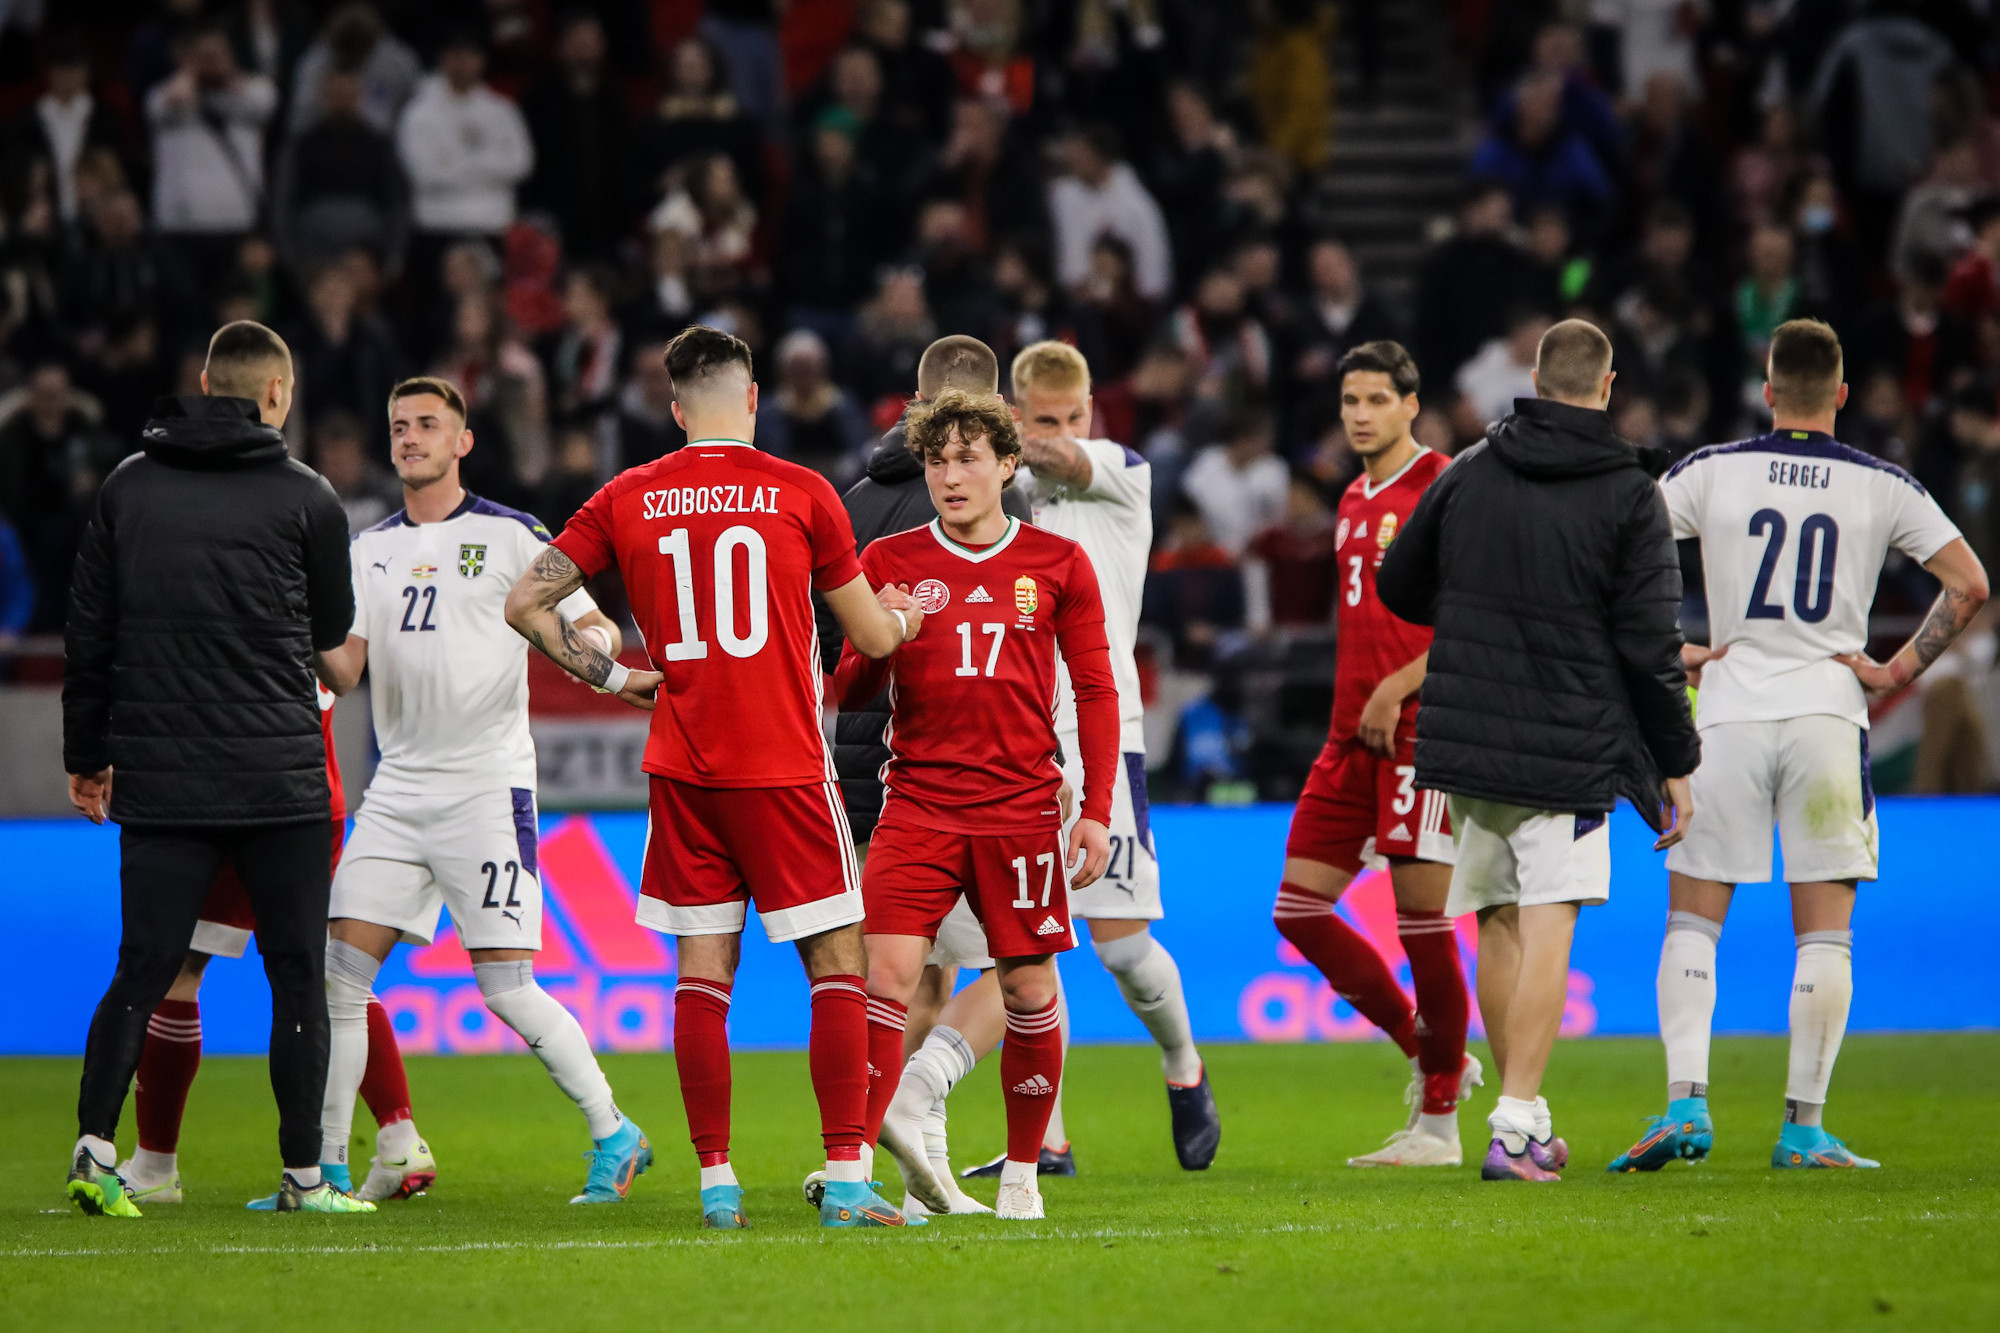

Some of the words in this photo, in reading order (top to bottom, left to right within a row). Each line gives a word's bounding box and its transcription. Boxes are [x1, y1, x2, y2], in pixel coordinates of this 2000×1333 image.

[1768, 460, 1831, 489] SERGEJ
[643, 485, 780, 520] SZOBOSZLAI
[1346, 555, 1363, 607] 3
[1745, 507, 1839, 623] 20
[400, 585, 437, 632] 22
[658, 525, 769, 661] 10
[955, 621, 1006, 677] 17
[1391, 765, 1416, 815] 3
[1012, 852, 1054, 908] 17
[1105, 835, 1136, 880] 21
[481, 860, 521, 908] 22
[1037, 925, 1065, 935] adidas
[379, 966, 666, 1054] adda
[1012, 1085, 1054, 1096] adidas
